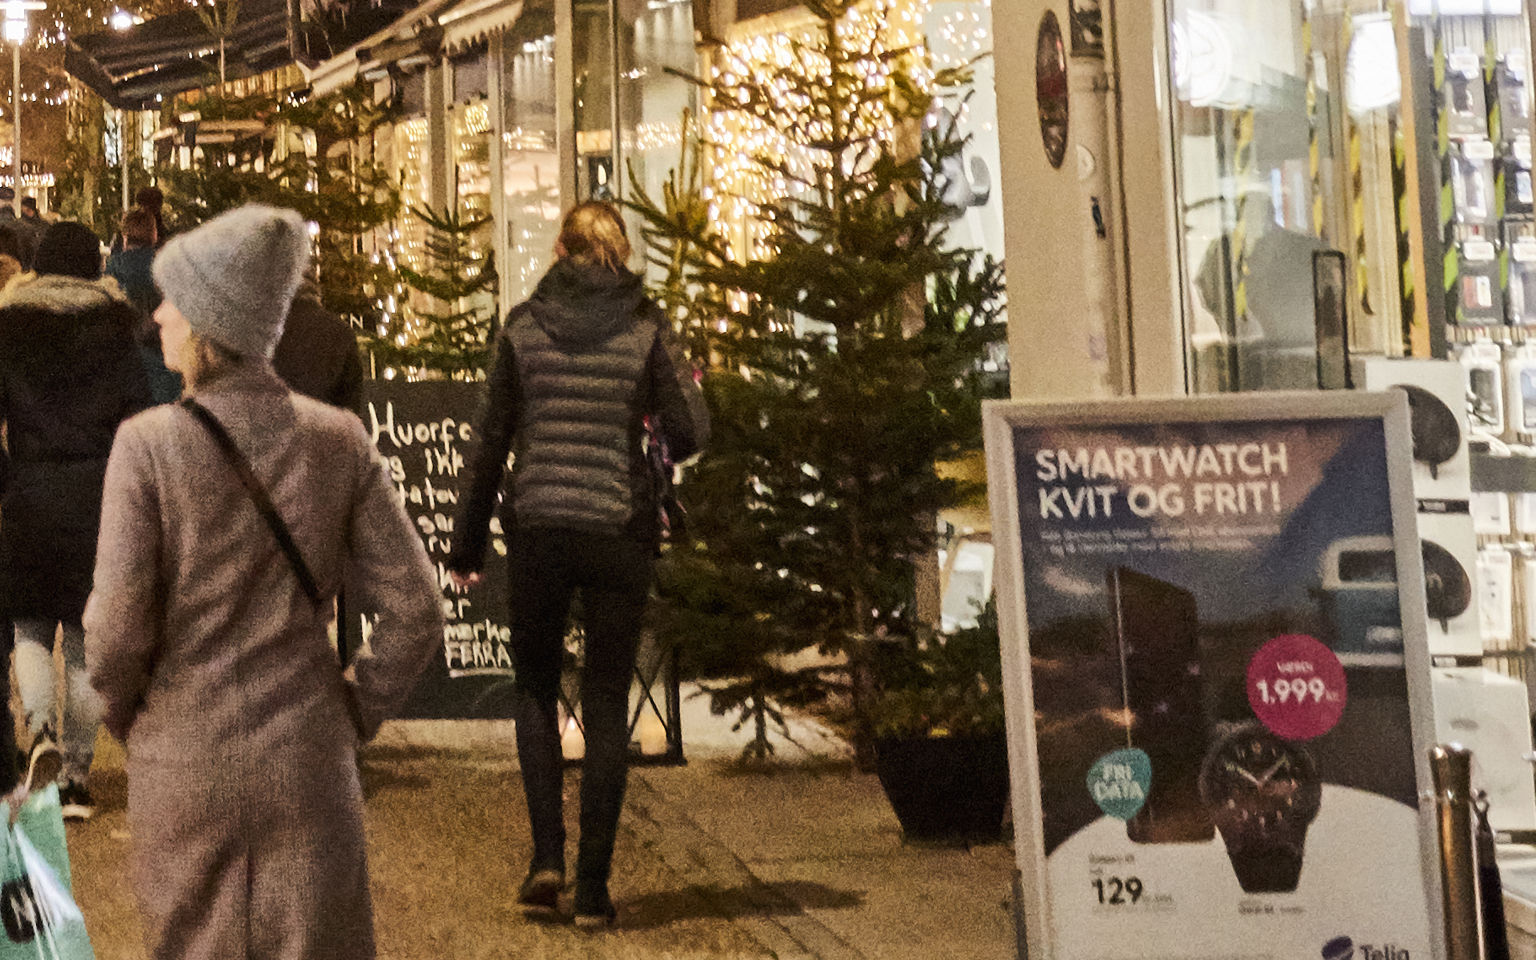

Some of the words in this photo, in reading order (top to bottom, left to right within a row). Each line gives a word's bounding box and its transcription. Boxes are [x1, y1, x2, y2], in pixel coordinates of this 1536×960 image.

[1036, 442, 1289, 481] SMARTWATCH
[1038, 486, 1117, 519] KVIT
[1127, 483, 1185, 517] OG
[1193, 481, 1282, 515] FRIT!
[1256, 677, 1325, 704] 1.999
[1091, 876, 1143, 905] 129
